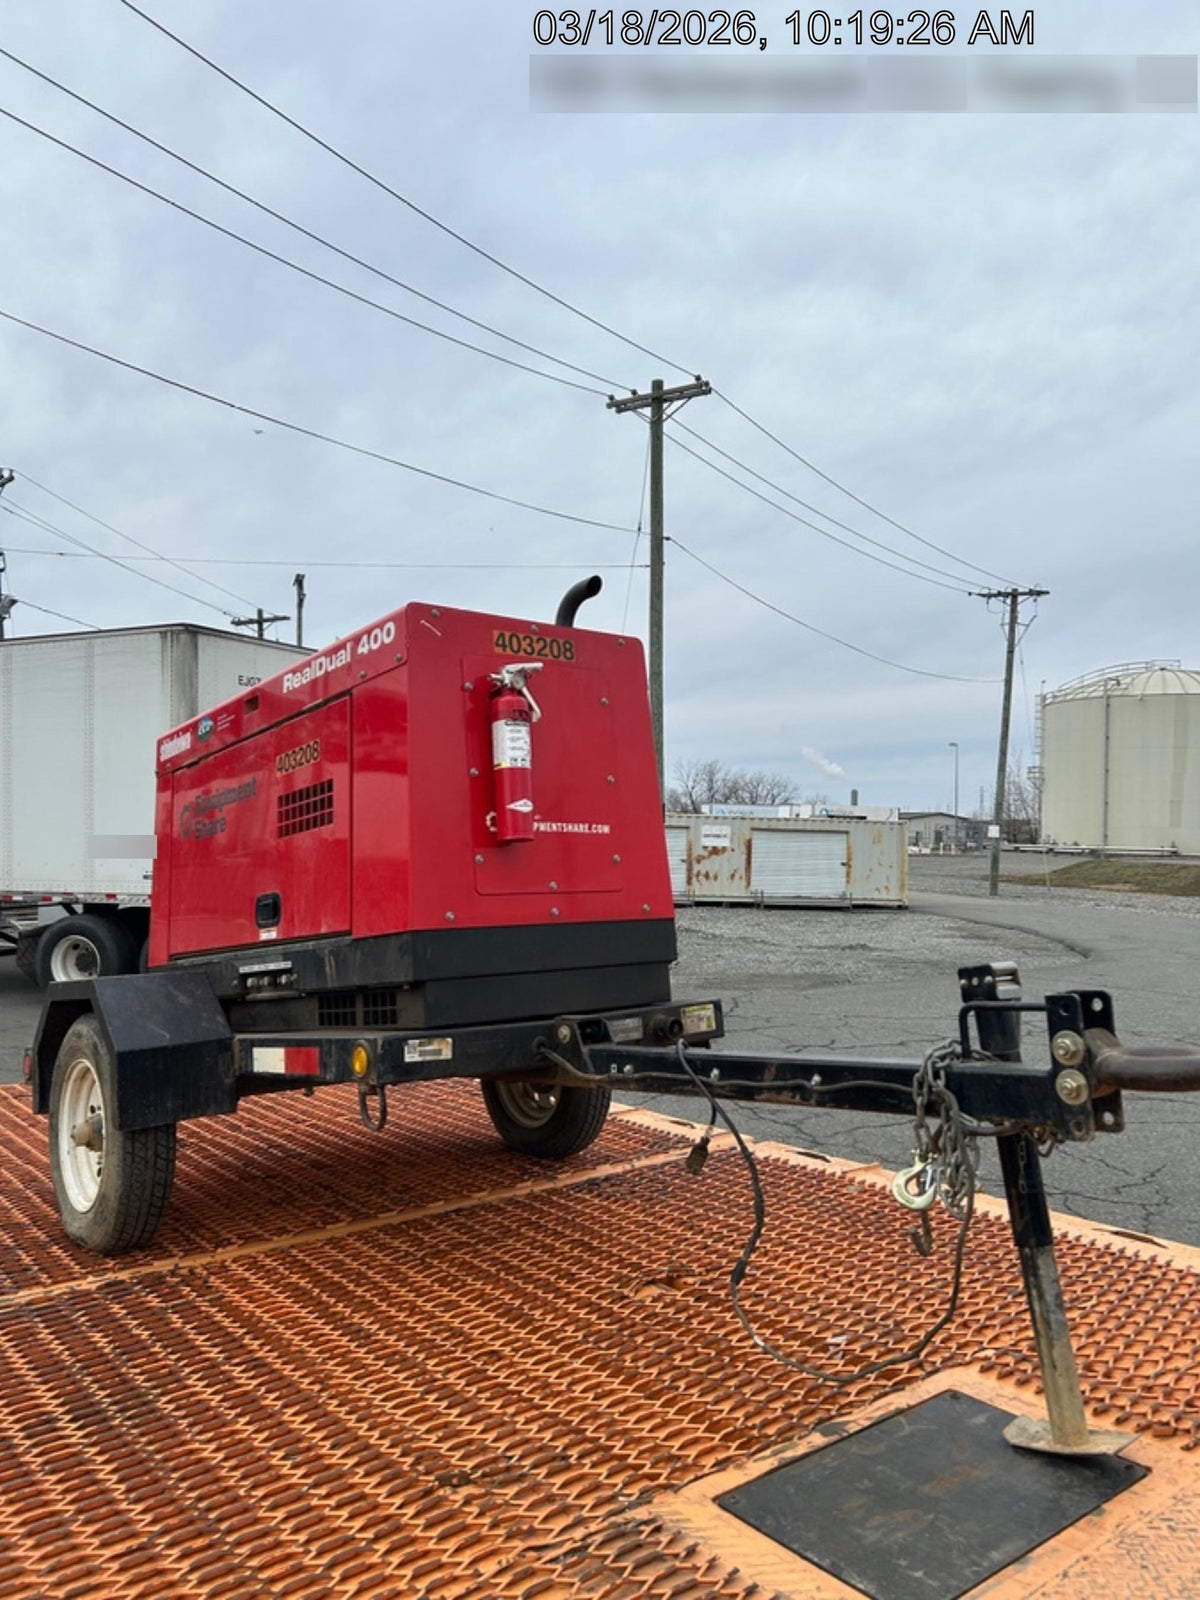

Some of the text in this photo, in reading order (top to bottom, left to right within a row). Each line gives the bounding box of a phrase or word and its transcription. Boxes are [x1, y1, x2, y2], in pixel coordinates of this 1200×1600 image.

[283, 621, 396, 694] RealDual 400
[495, 632, 575, 661] 403208
[276, 741, 320, 775] 403208
[195, 817, 227, 840] Share
